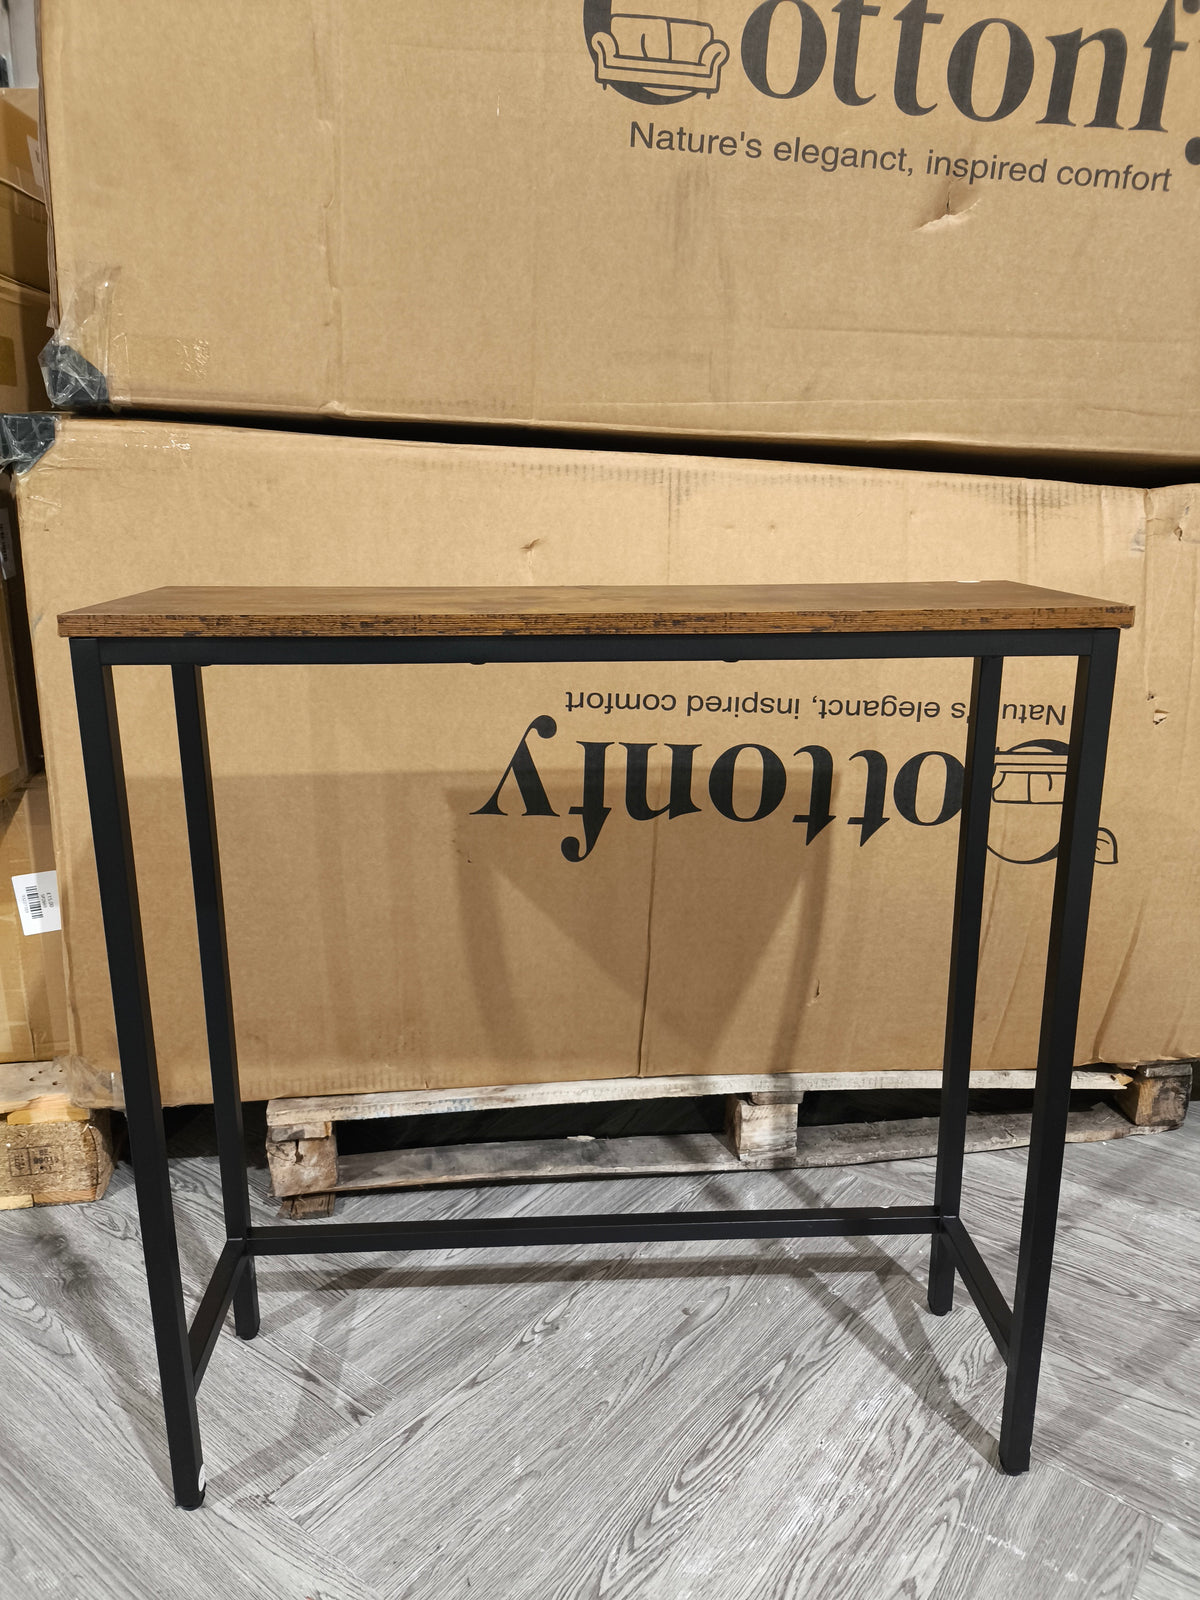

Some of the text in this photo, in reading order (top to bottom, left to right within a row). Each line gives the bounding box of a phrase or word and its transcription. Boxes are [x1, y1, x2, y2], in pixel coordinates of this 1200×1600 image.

[629, 121, 1173, 192] Nature's eleganct, inspired comfort
[565, 691, 1067, 726] Natu's eleganct, inspired comfort
